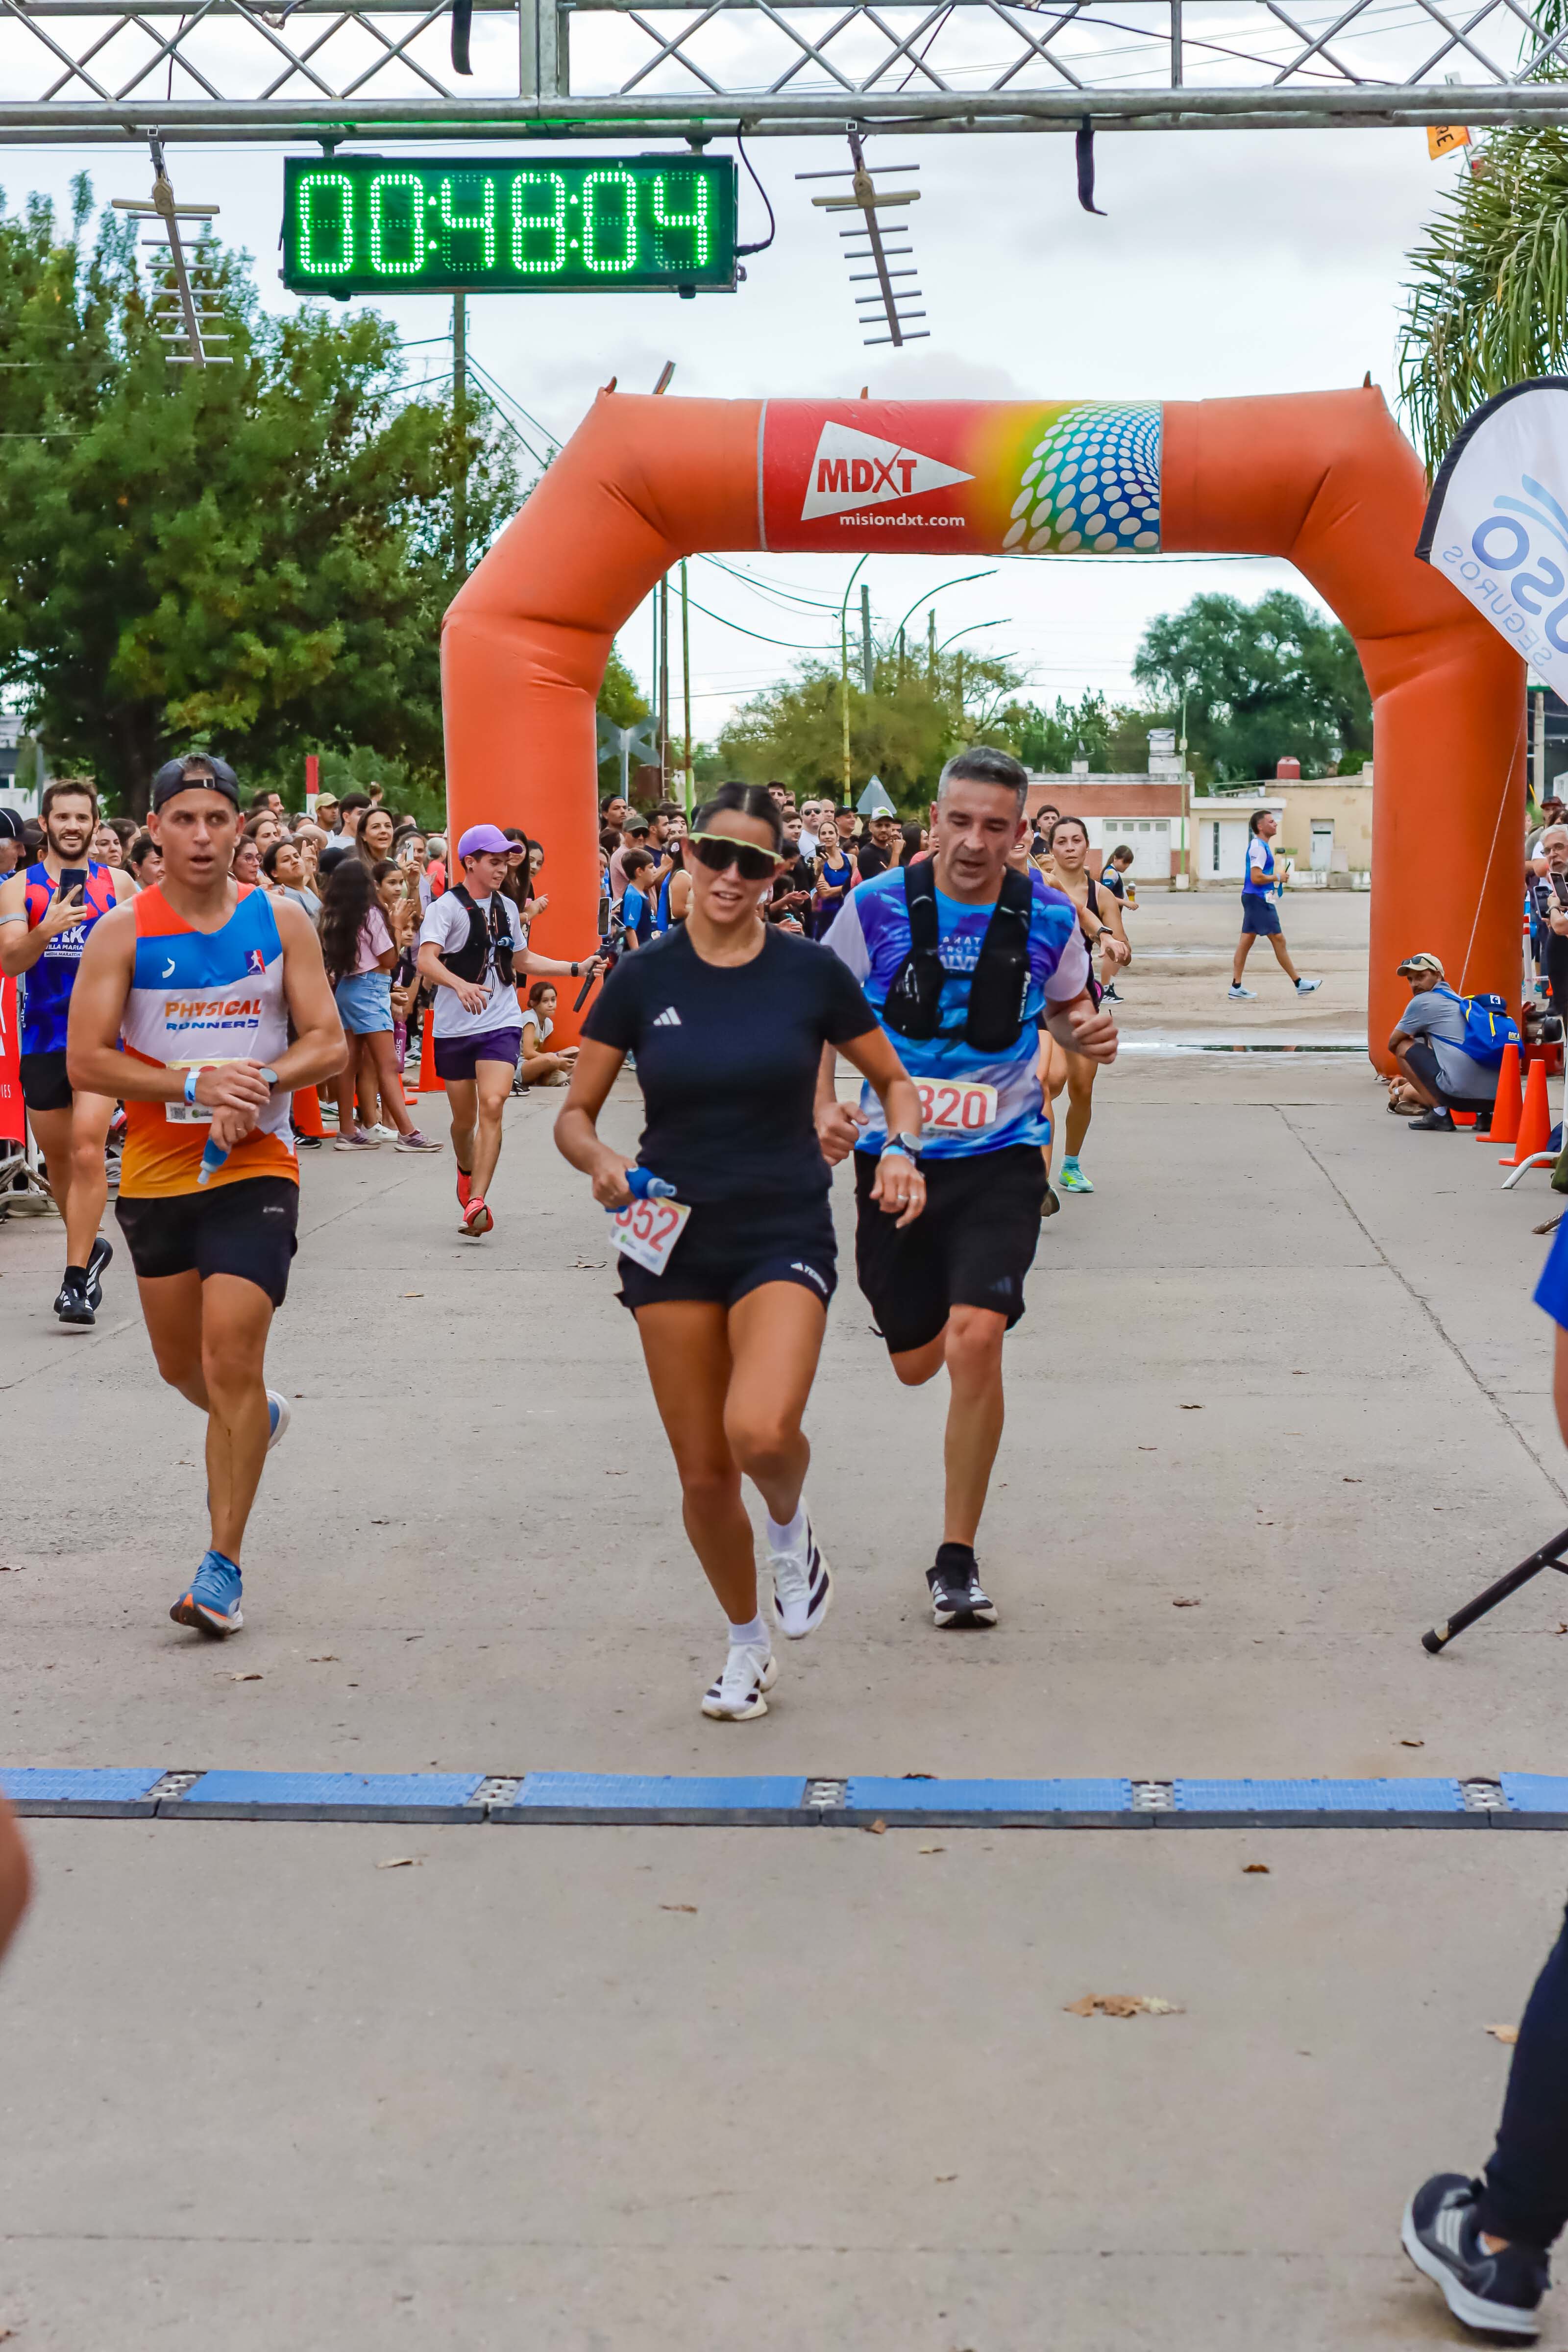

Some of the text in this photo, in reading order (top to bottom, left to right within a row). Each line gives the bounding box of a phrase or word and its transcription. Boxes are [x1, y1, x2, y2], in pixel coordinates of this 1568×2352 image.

[299, 172, 708, 273] 00:48:04
[817, 447, 917, 496] MDXT
[839, 513, 965, 526] misiondxt.com
[165, 999, 261, 1017] PHYSICAL
[166, 1019, 259, 1030] RUNNERS
